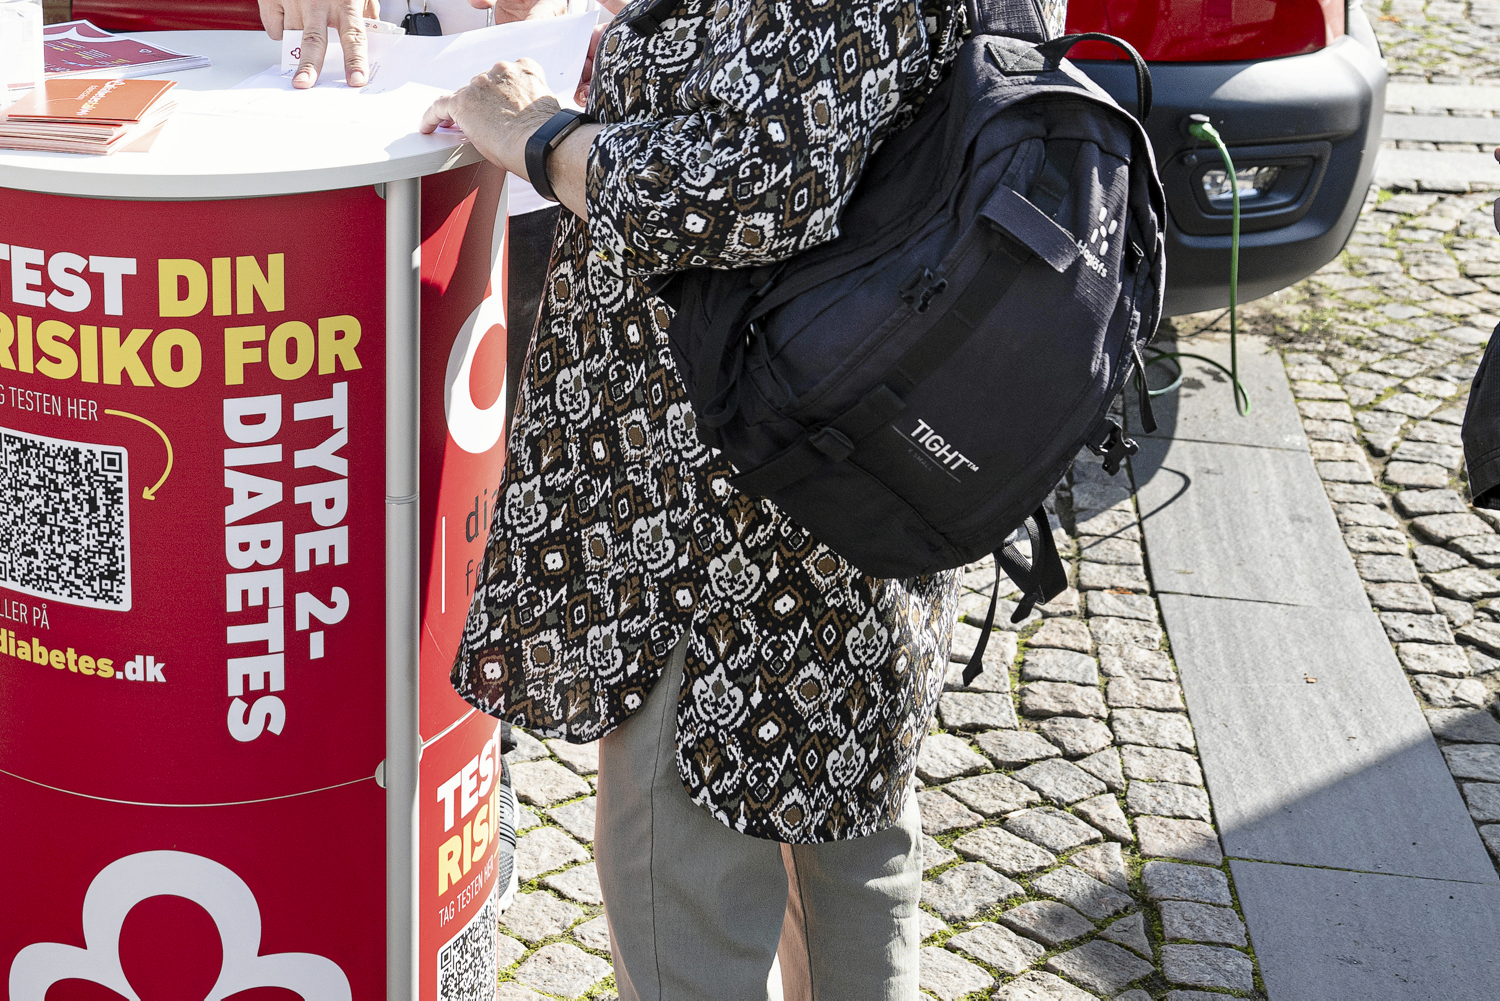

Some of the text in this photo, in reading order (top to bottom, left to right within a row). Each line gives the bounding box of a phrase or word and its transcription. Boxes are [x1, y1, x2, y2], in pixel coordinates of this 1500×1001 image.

[158, 253, 286, 318] DIN
[1077, 239, 1108, 278] Haglöfs
[224, 314, 363, 386] FOR
[8, 385, 63, 417] TESTEN
[67, 396, 99, 422] HER
[293, 381, 350, 661] TYPE 2-
[222, 393, 287, 743] DIABETES
[31, 602, 50, 631] PÅ
[437, 720, 500, 833] TEST
[438, 853, 494, 928] TAG TESTEN HER
